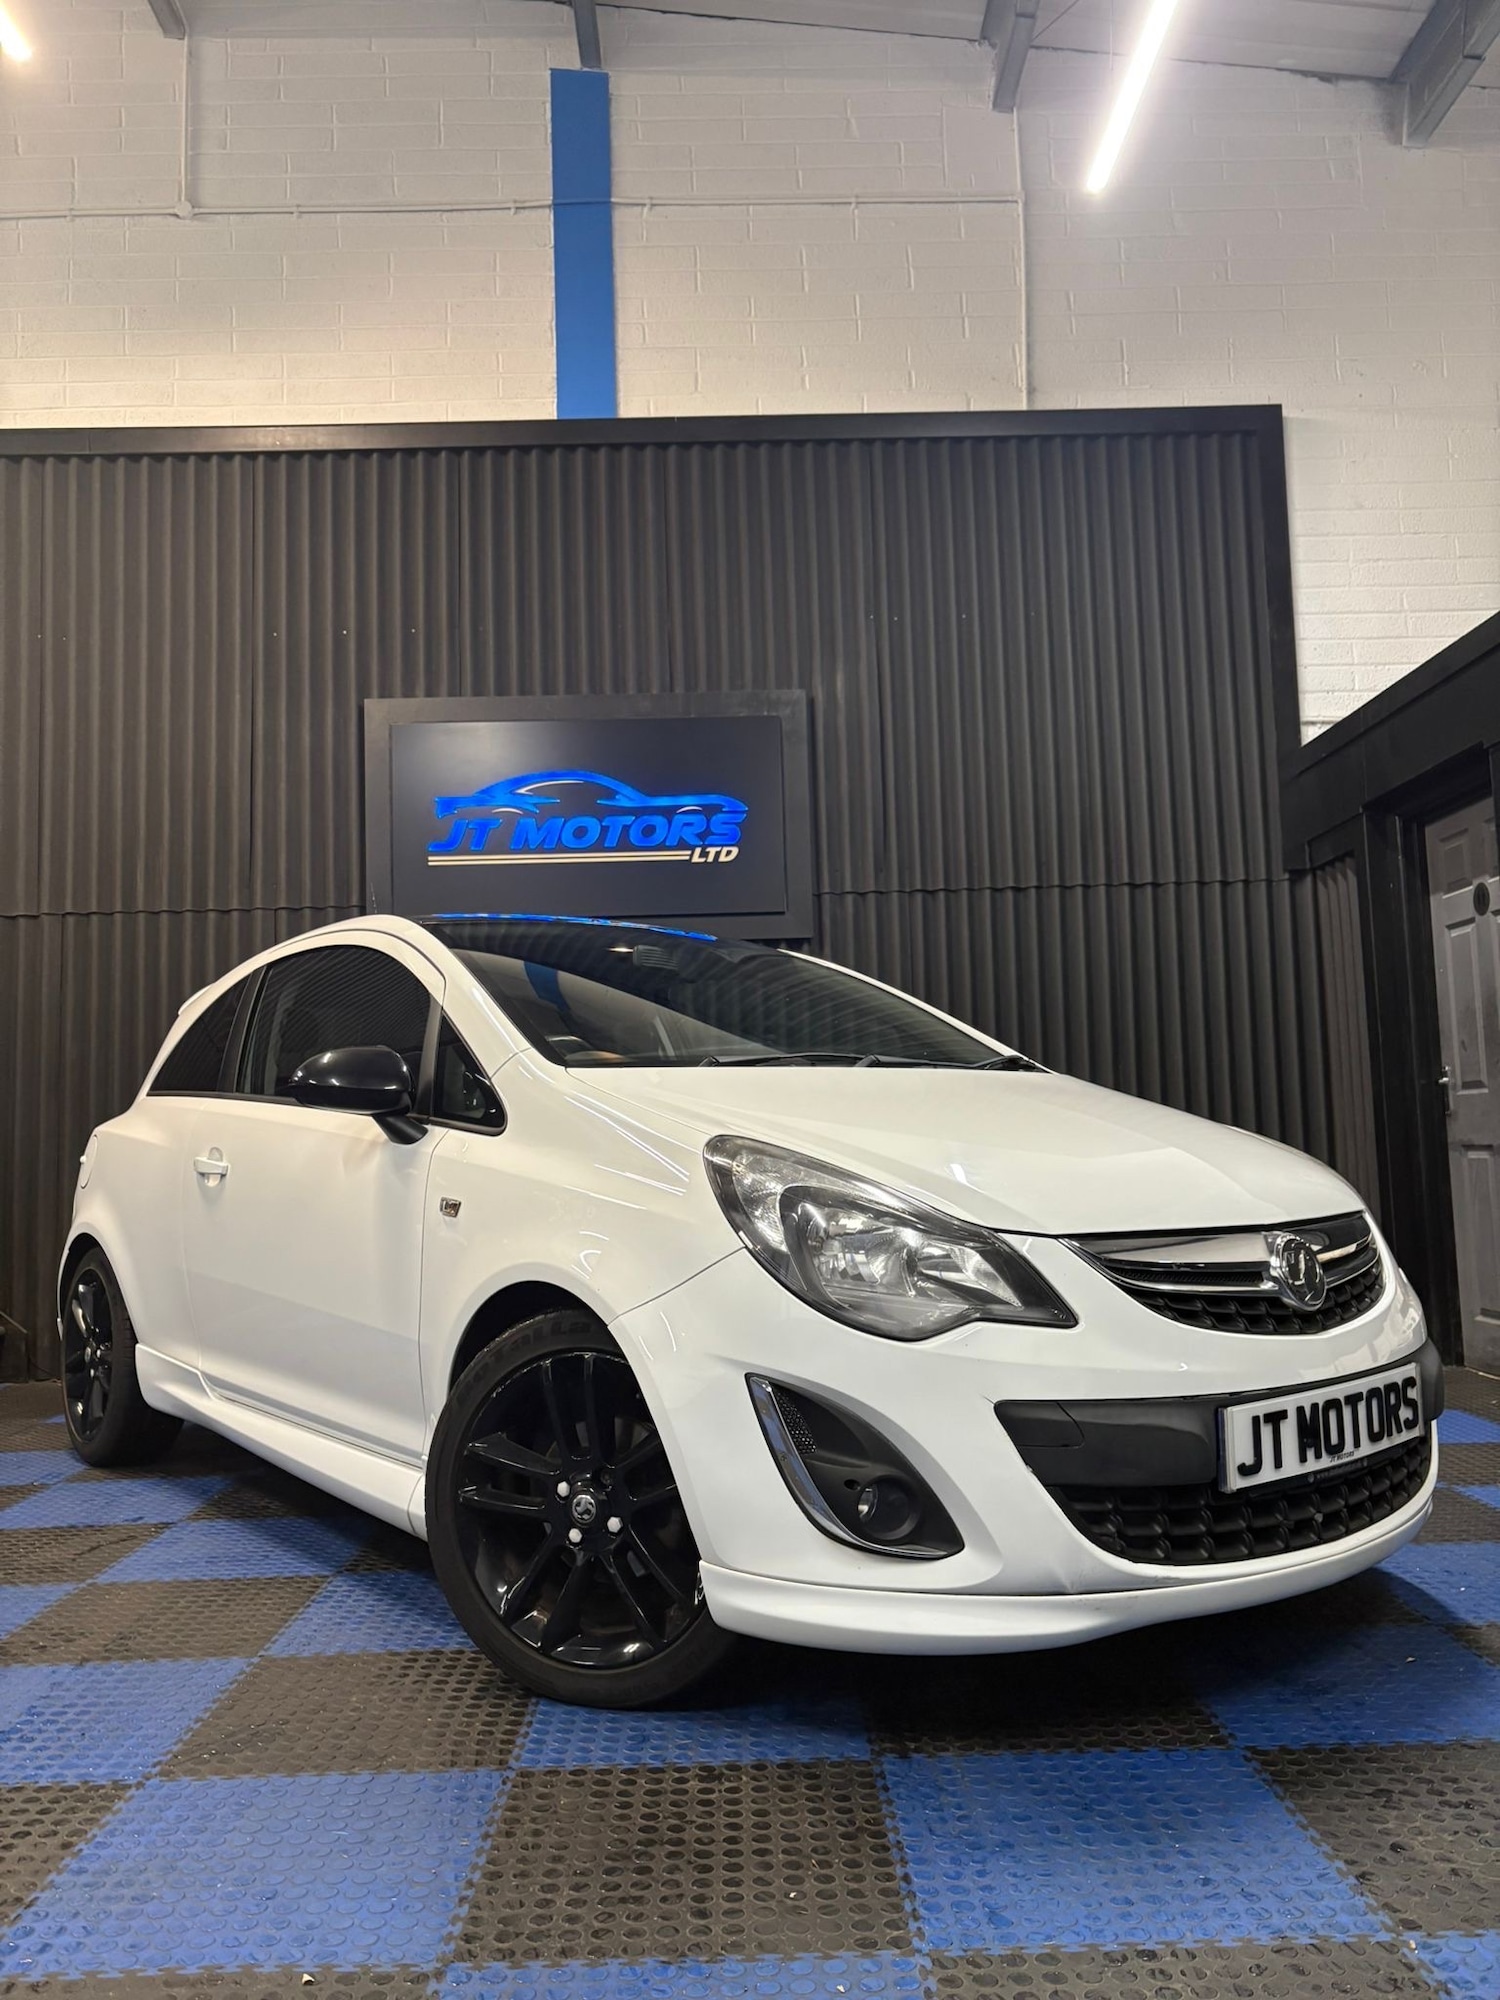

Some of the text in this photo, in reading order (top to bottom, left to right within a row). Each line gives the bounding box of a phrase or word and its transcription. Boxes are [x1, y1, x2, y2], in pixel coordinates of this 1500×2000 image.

[428, 814, 747, 851] JT MOTORS
[691, 847, 739, 863] LTD
[1237, 1376, 1419, 1476] JT MOTORS
